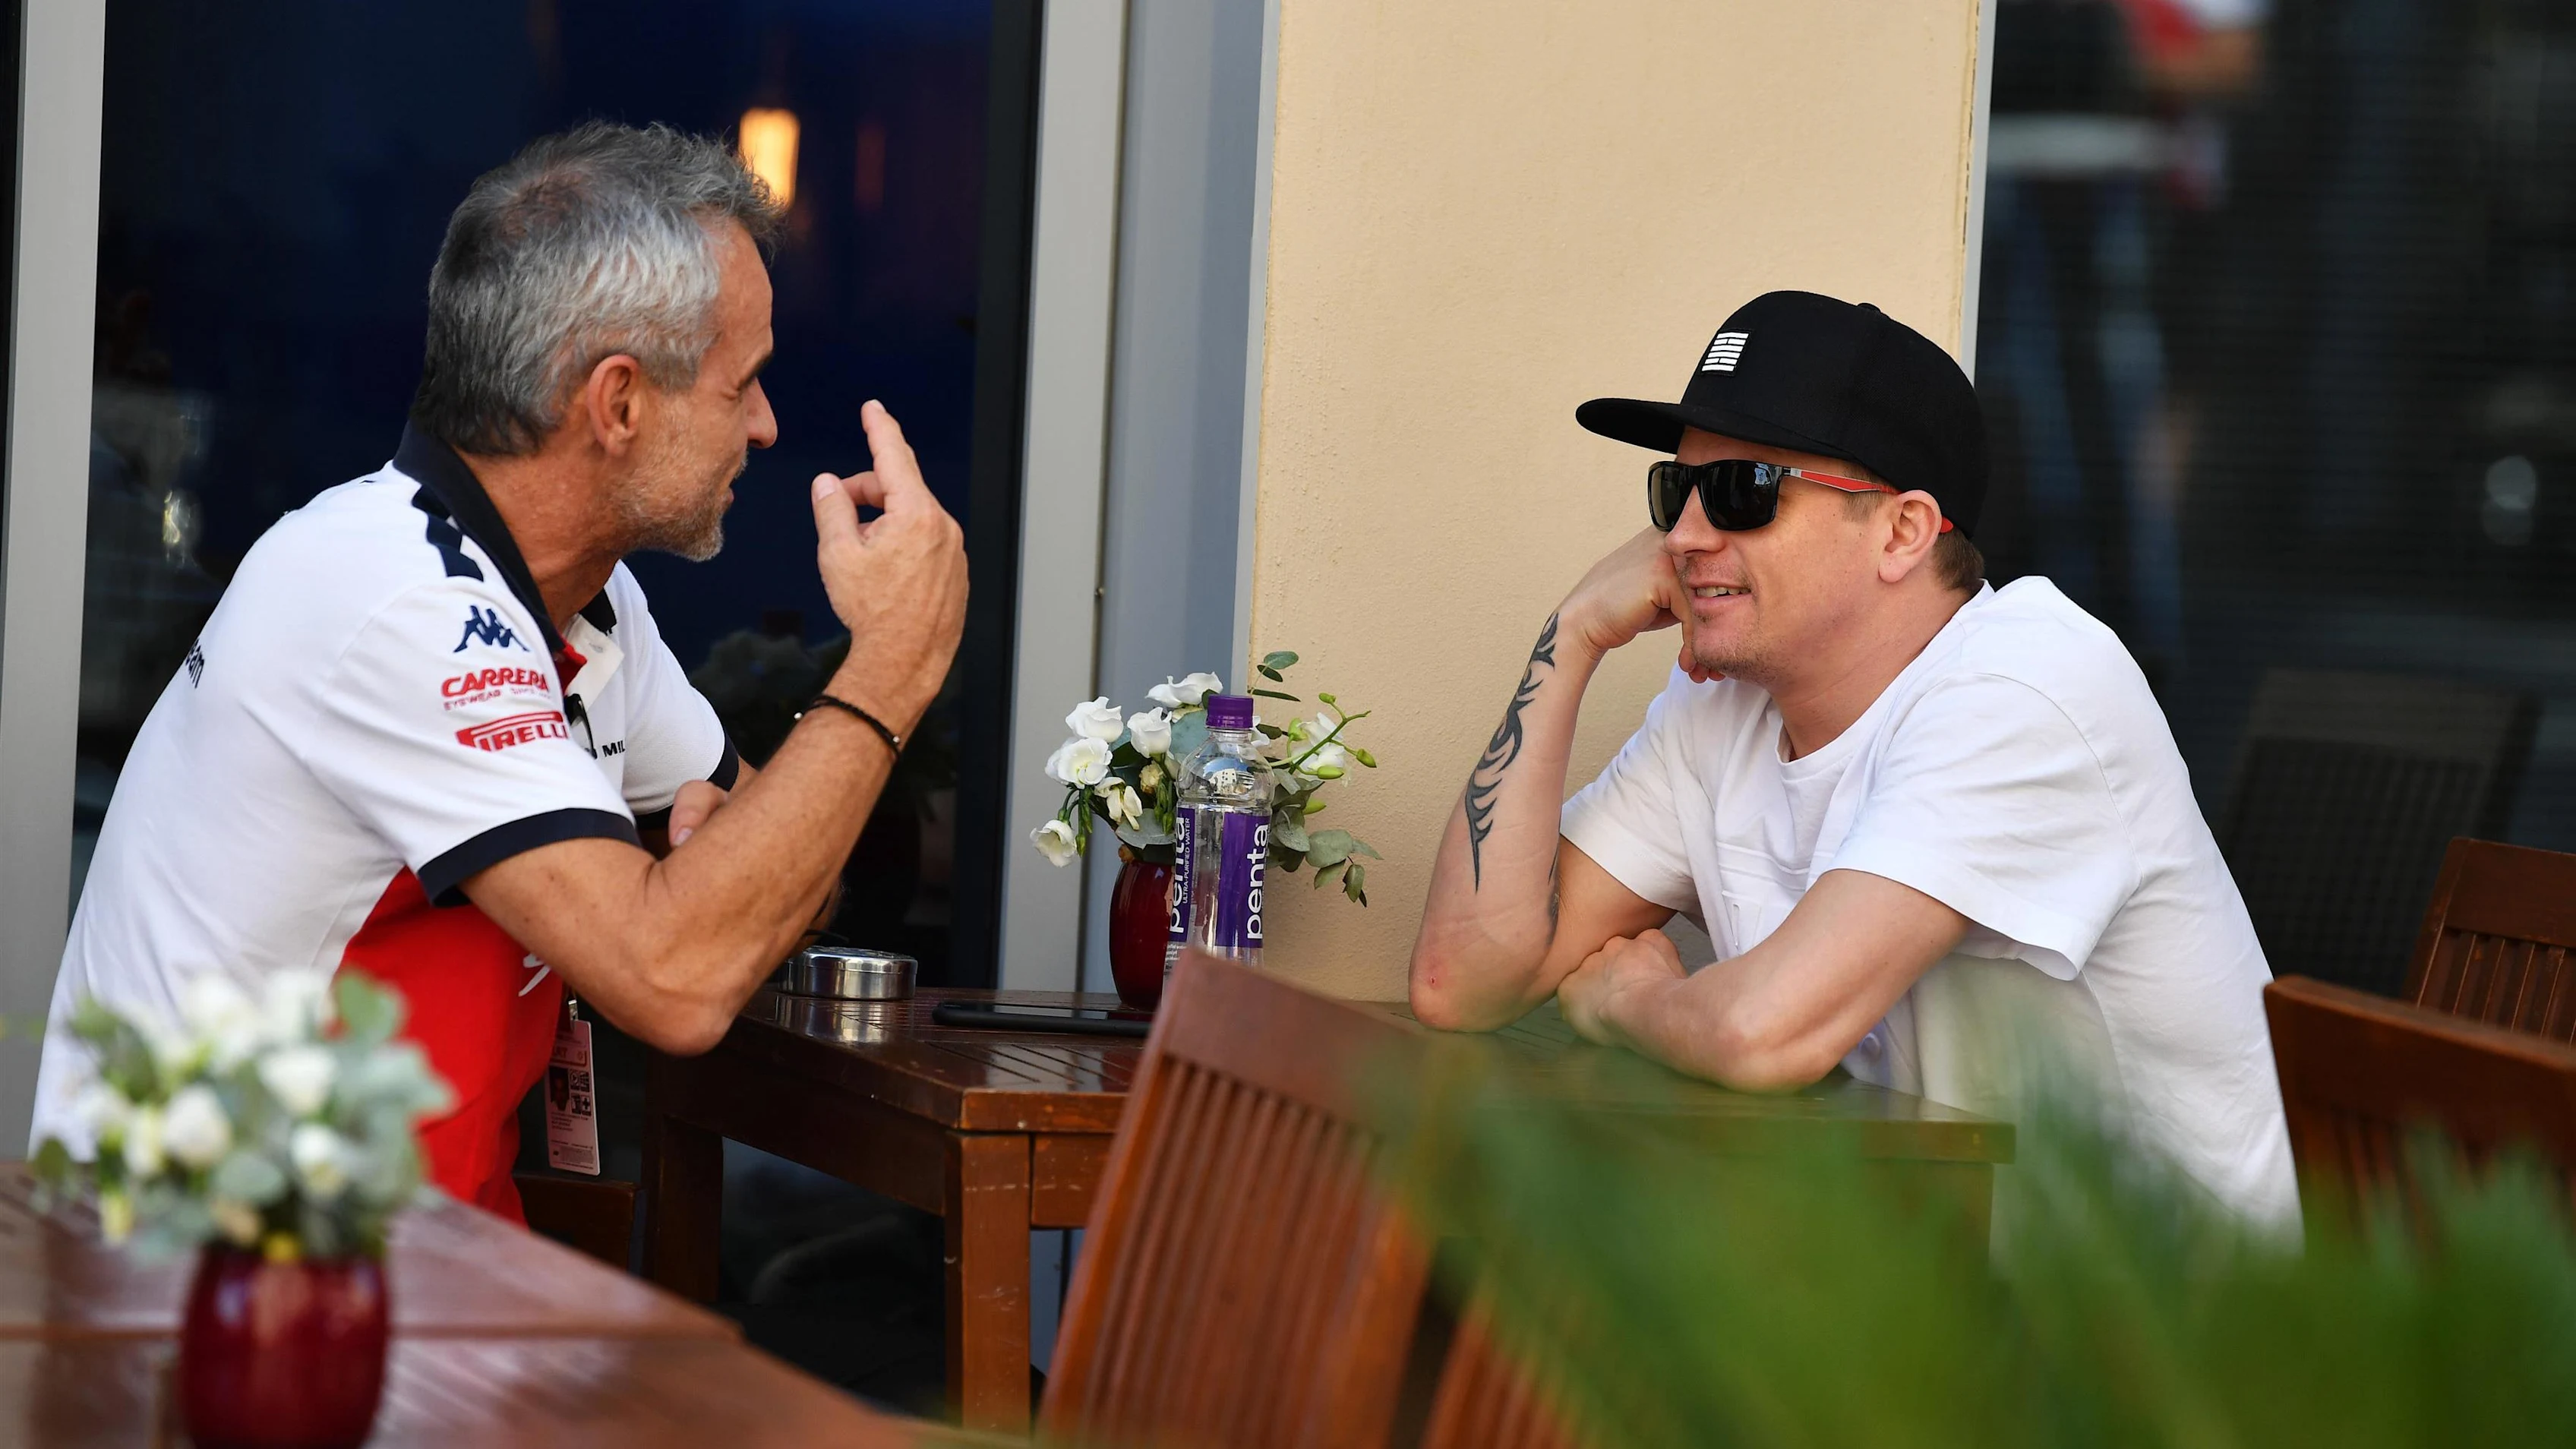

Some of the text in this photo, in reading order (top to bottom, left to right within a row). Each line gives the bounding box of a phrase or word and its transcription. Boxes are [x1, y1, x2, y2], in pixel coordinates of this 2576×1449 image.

[441, 668, 549, 697] CARRERA
[456, 711, 568, 752] PIRELLI
[1246, 823, 1269, 939] penta
